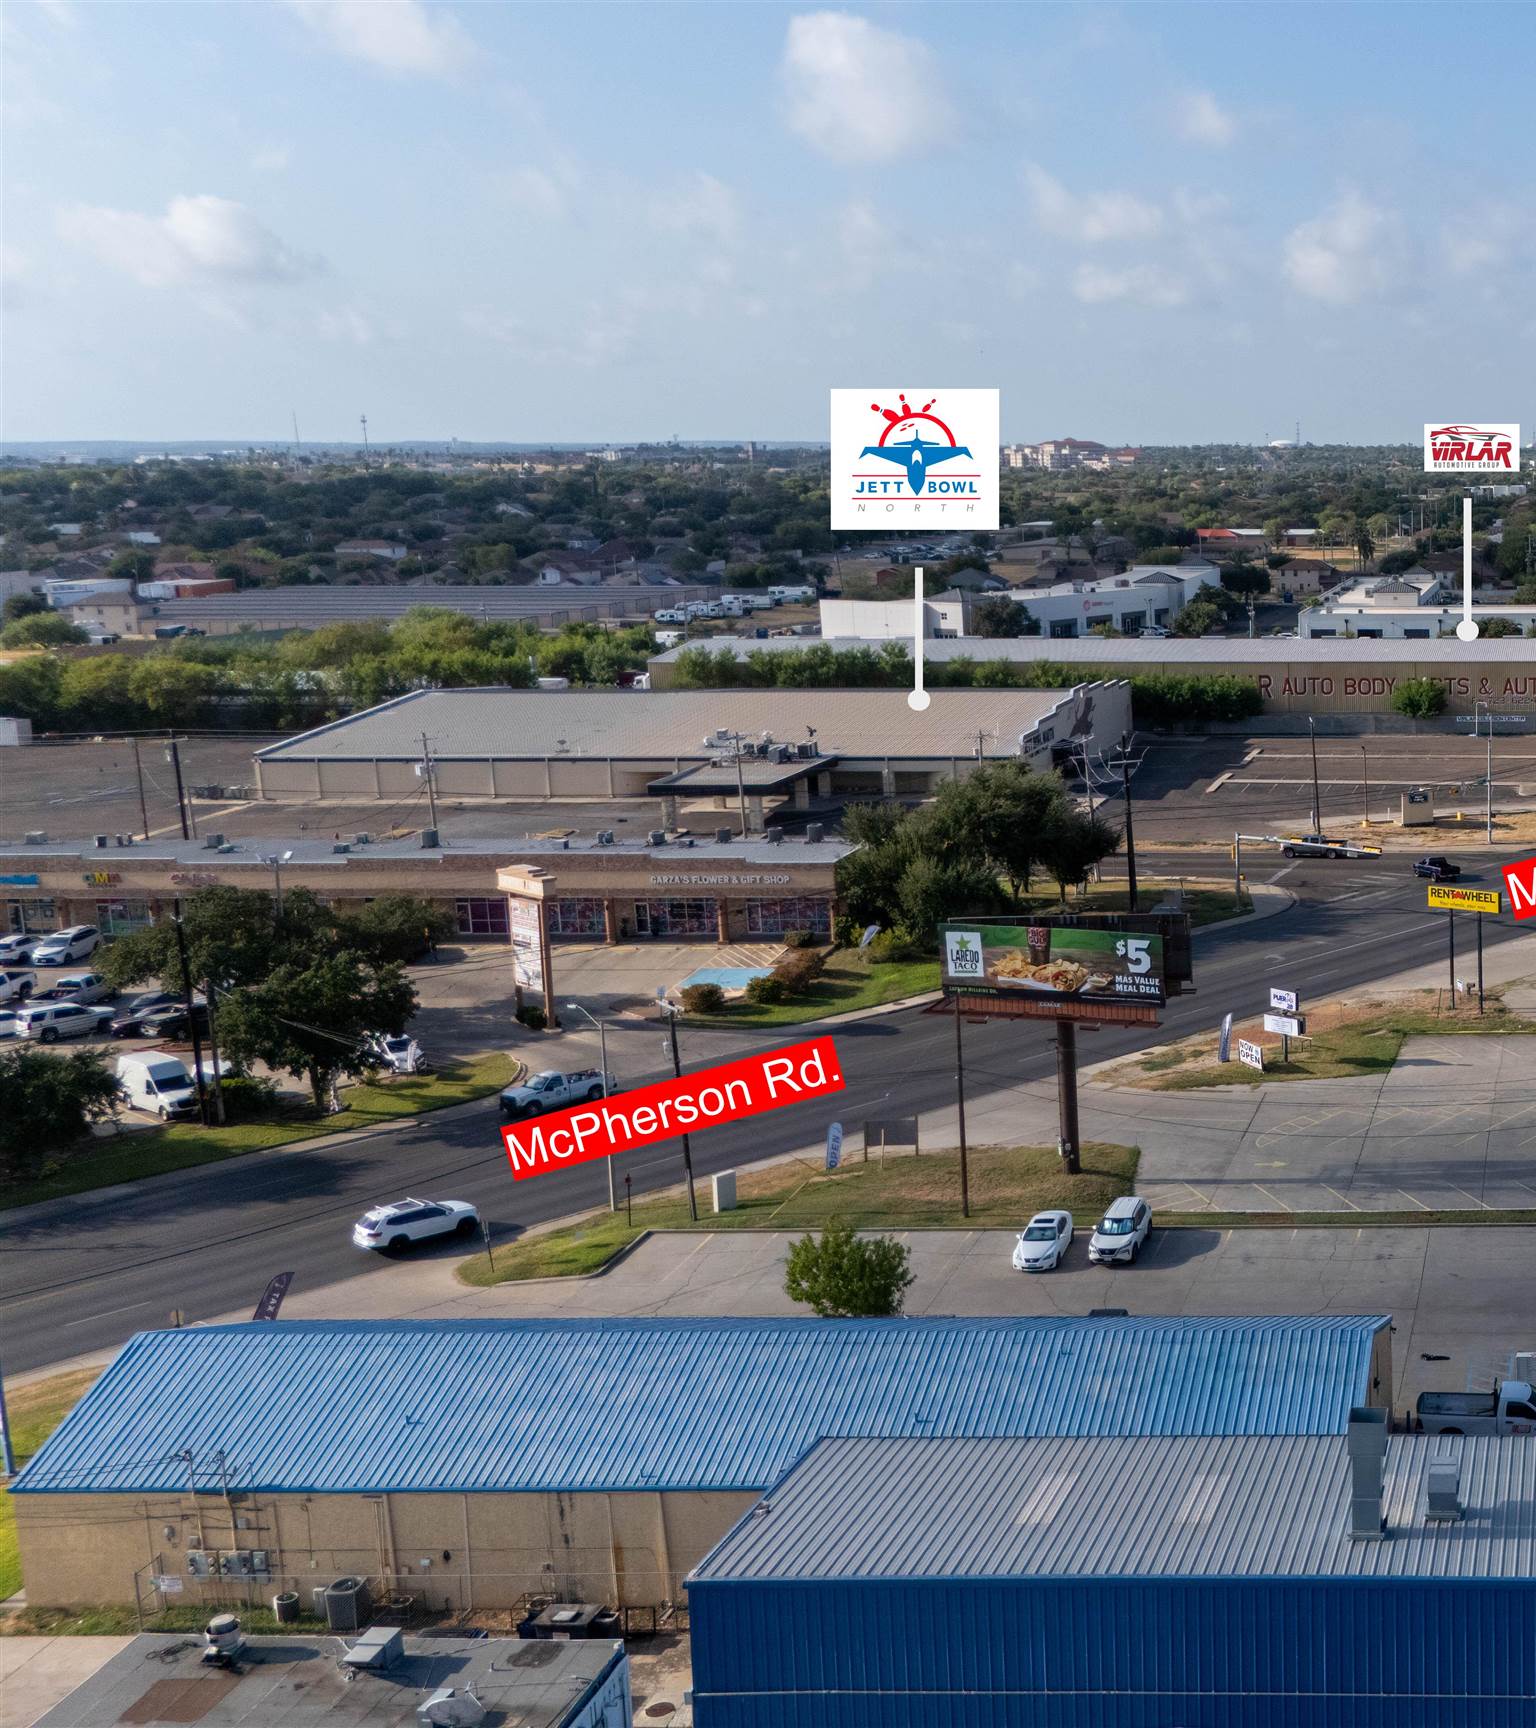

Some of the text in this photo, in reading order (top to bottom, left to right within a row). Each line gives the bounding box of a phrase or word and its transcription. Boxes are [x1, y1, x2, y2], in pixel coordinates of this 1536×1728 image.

[1282, 677, 1334, 696] AUTO
[1344, 677, 1397, 696] BODY
[1479, 677, 1494, 696] &
[651, 876, 690, 884] GARZA'S
[691, 876, 730, 884] FLOWER
[740, 876, 760, 884] GIFT
[763, 876, 790, 884] SHOP
[951, 949, 980, 963] LAREDO
[1116, 939, 1151, 974] $5
[953, 962, 978, 970] TACO
[1115, 976, 1160, 985] MAS VALUE
[1116, 984, 1160, 994] MEAL DEAL
[1240, 1040, 1254, 1053] NOW
[1241, 1050, 1261, 1064] OPEN
[829, 1135, 841, 1168] OPEN
